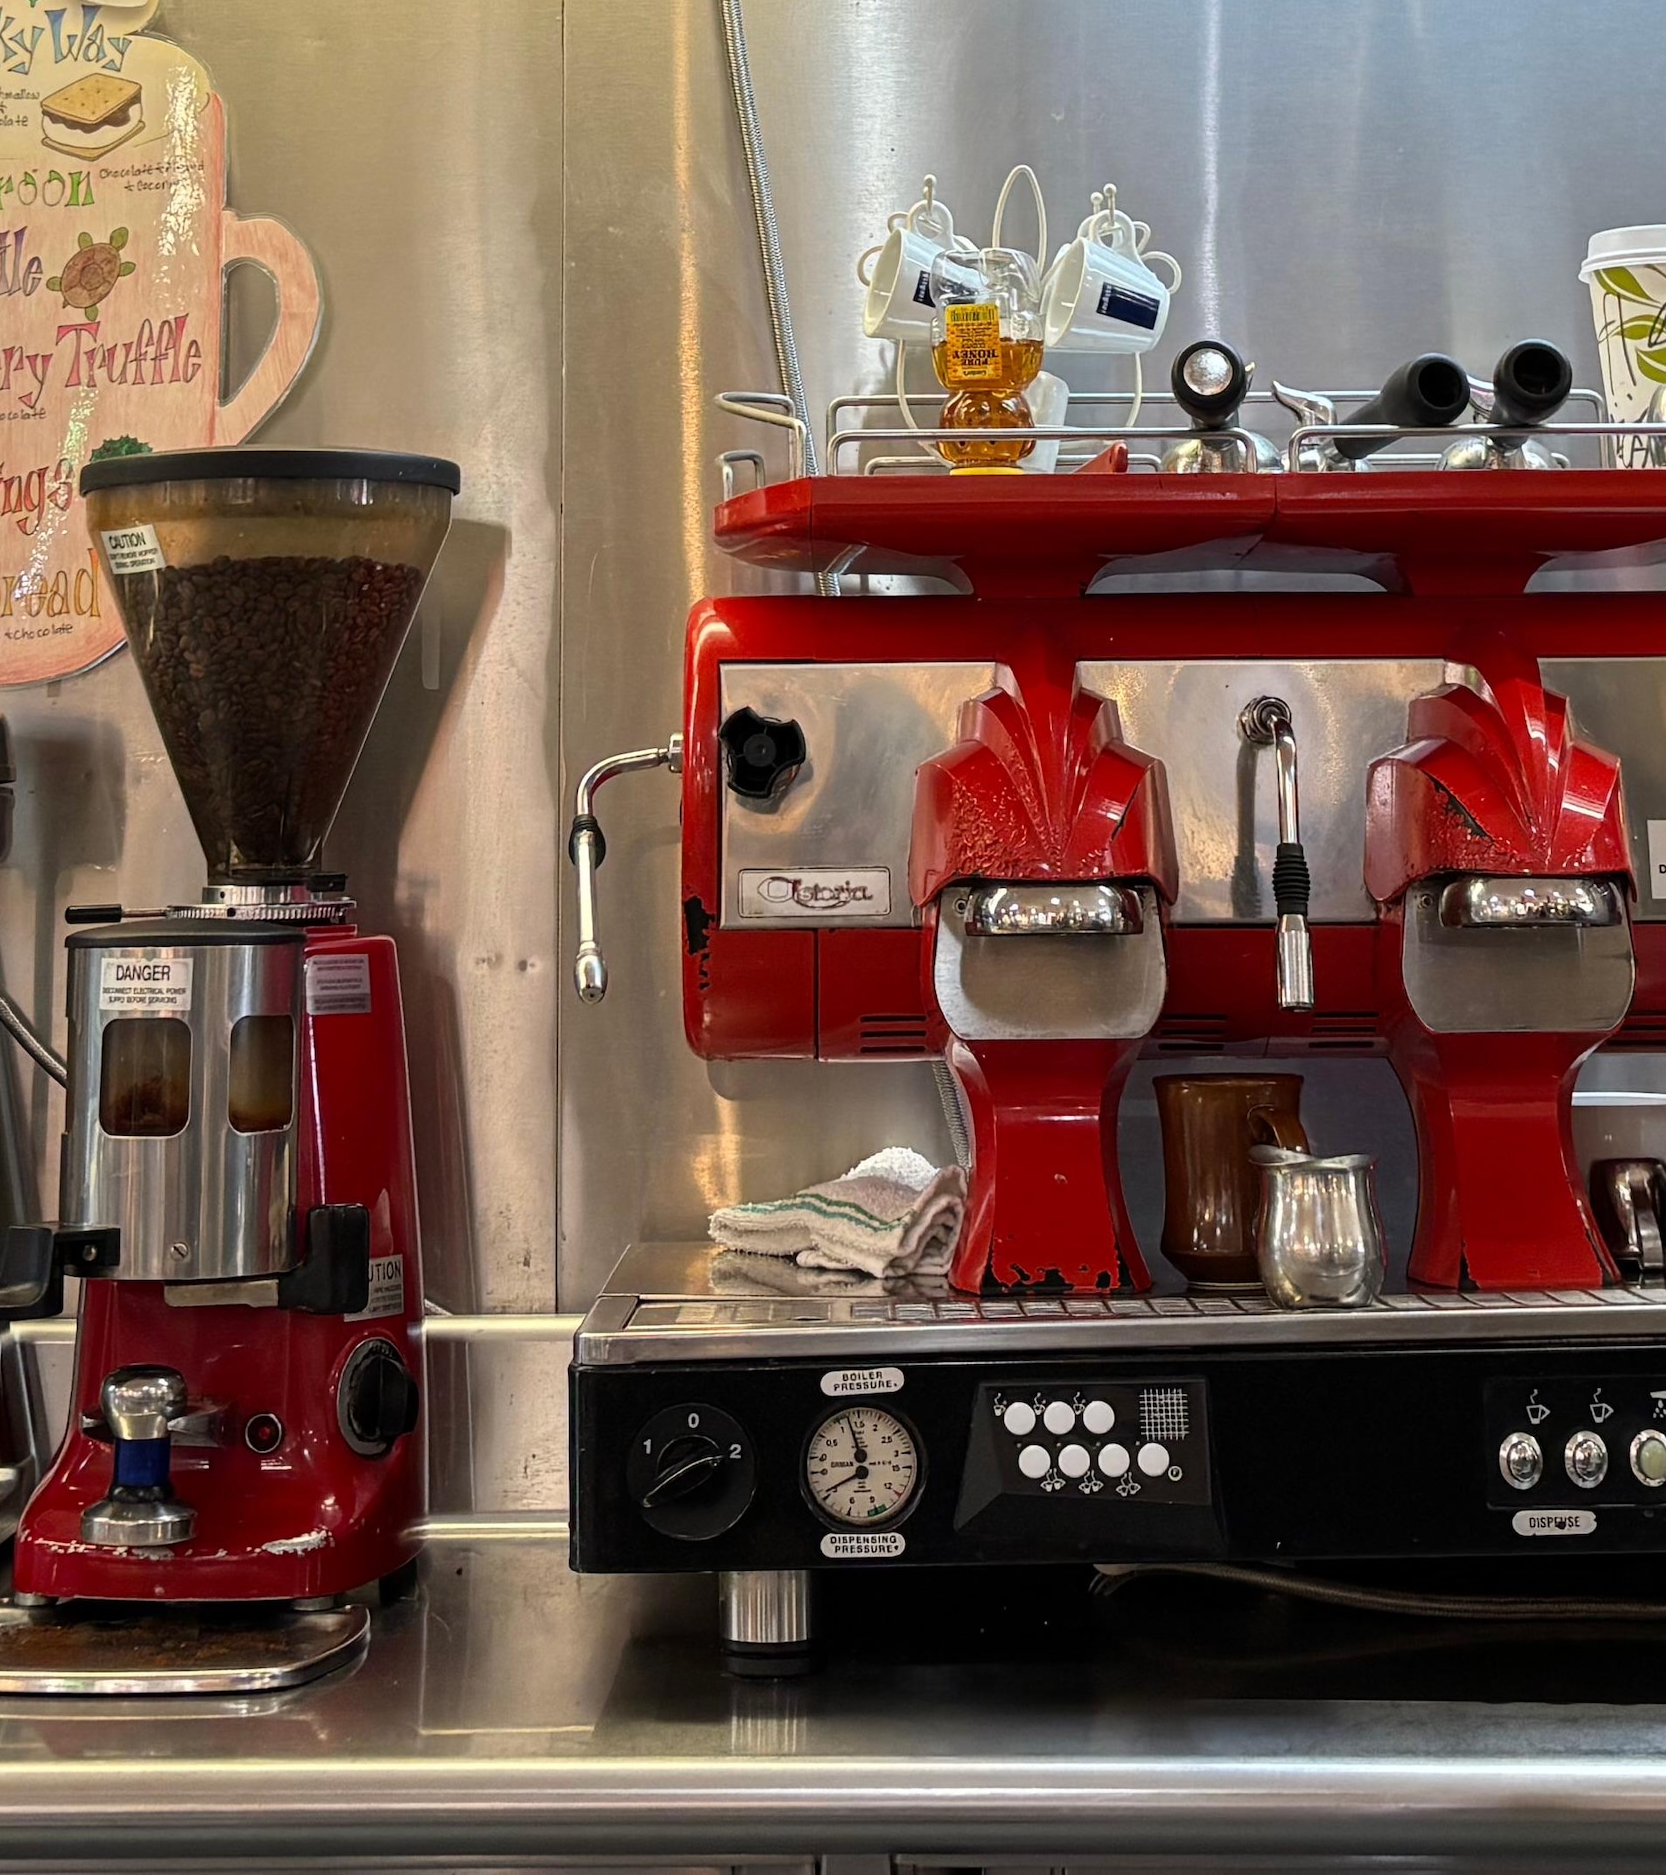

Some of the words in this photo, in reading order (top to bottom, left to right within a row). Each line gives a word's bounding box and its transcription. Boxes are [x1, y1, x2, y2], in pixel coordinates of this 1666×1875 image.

[44, 4, 133, 71] Way
[56, 312, 203, 391] Truffle
[108, 531, 147, 550] CAUTION
[115, 964, 171, 982] DANGER
[842, 1371, 884, 1382] BOILER
